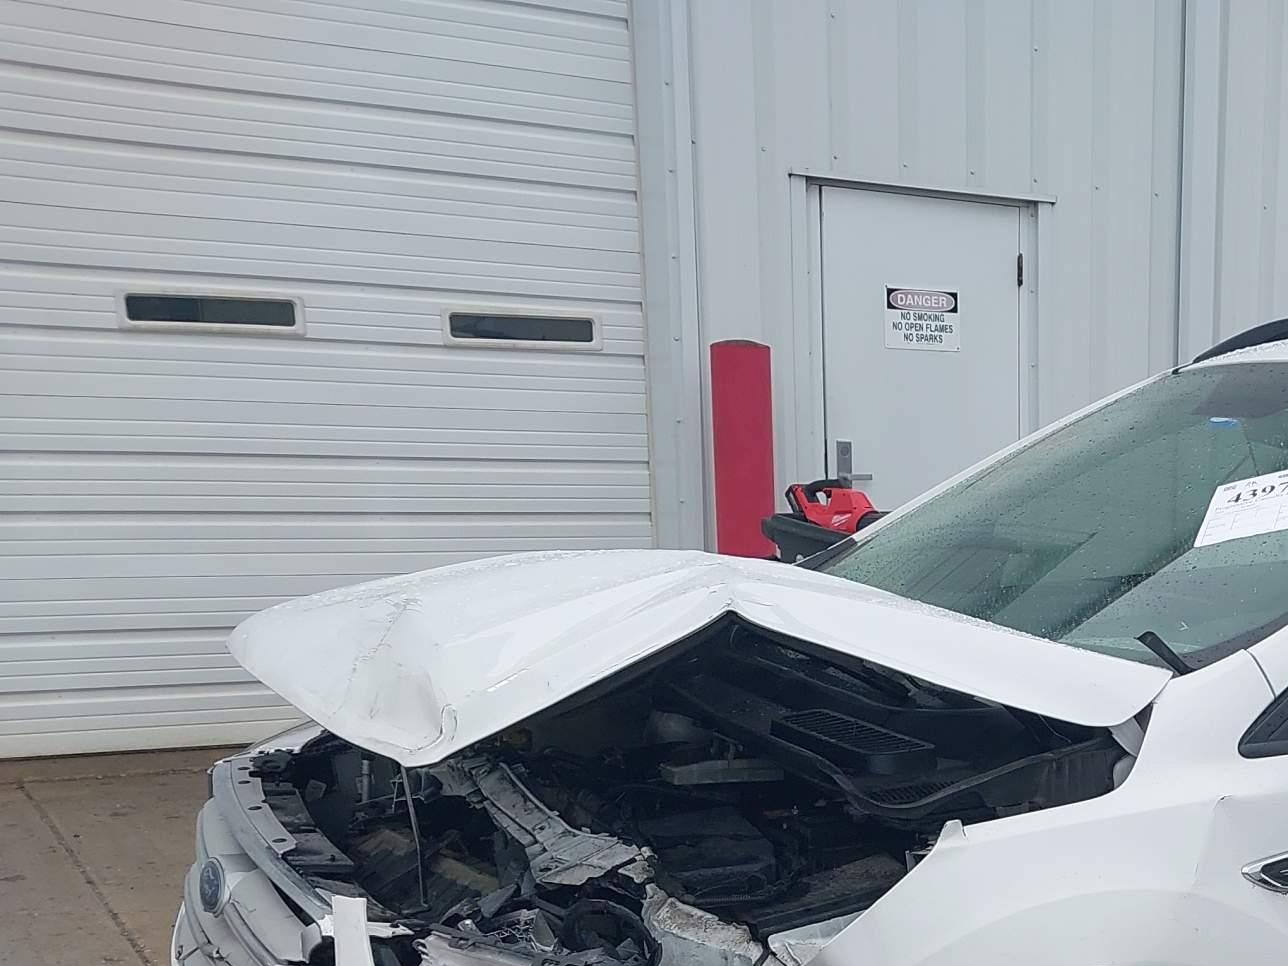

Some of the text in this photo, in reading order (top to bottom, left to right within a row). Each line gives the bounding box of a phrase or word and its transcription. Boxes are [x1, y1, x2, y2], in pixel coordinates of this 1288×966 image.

[897, 294, 947, 307] DANGER
[901, 312, 945, 323] NO SMOKING
[892, 322, 953, 333] NO OPEN FLAMES
[904, 333, 943, 343] NO SPARKS
